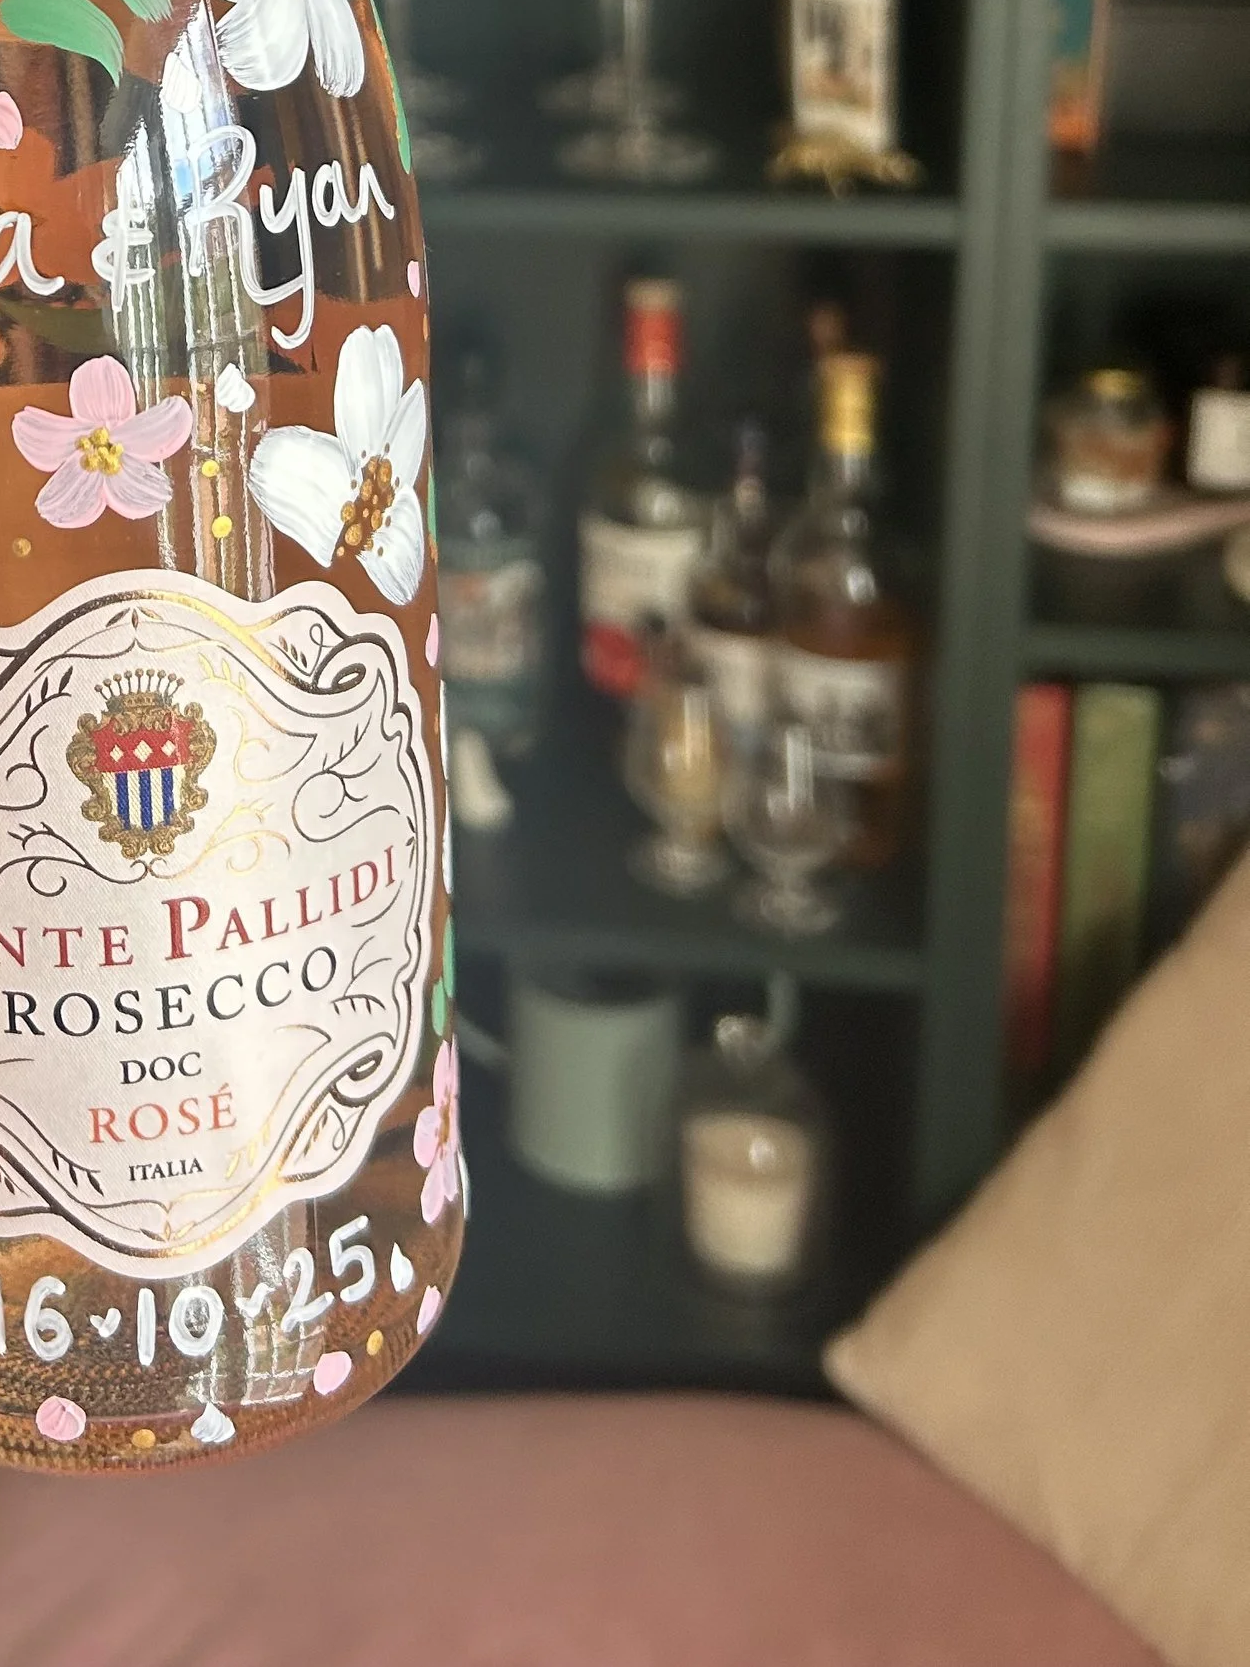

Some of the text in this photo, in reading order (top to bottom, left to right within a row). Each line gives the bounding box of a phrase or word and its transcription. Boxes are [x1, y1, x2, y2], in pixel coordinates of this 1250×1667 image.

[91, 168, 156, 313] &
[183, 124, 395, 349] Ryan
[161, 844, 398, 963] PALLIDI
[120, 1050, 202, 1085] DOC
[87, 1087, 238, 1145] ROSÉ
[128, 1156, 204, 1183] ITALIA
